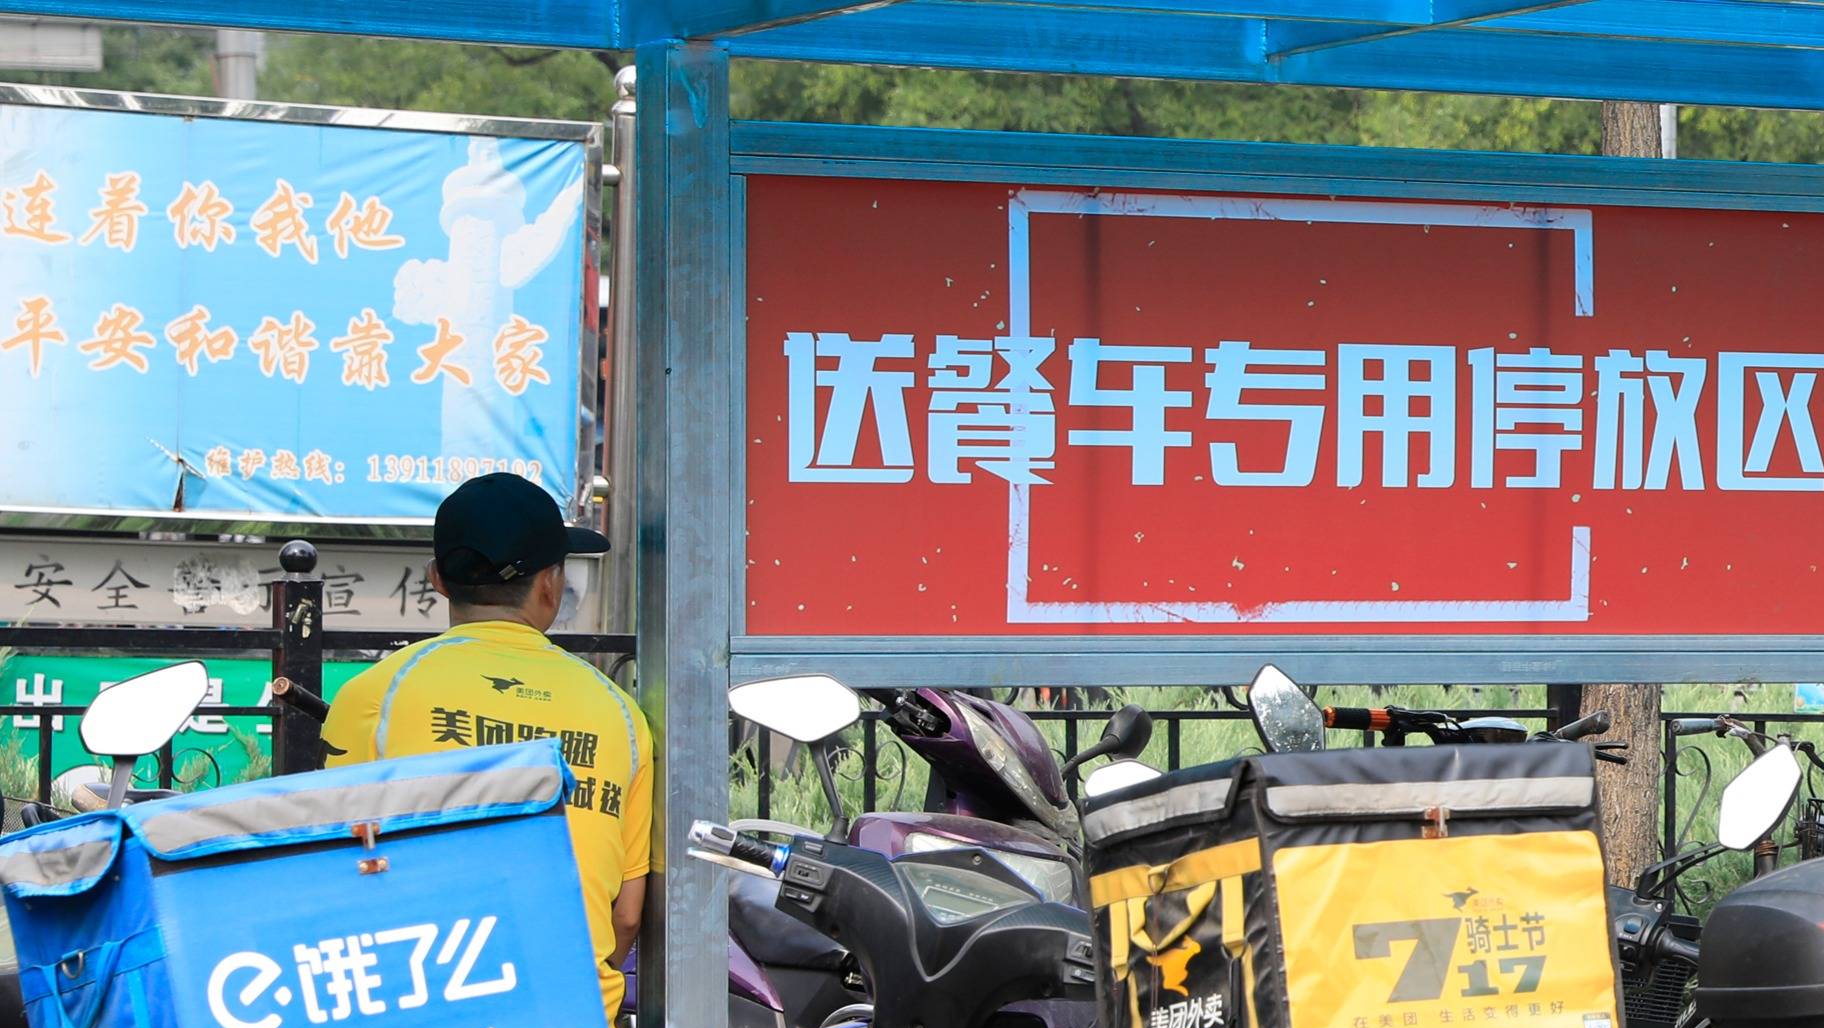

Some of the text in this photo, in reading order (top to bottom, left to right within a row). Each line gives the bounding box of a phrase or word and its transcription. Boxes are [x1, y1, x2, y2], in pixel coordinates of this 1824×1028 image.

[2, 170, 405, 263] 连着你我他
[1, 297, 551, 396] 平安和谐靠大家
[297, 916, 517, 1024] 饿了么
[1465, 911, 1546, 954] 骑士节
